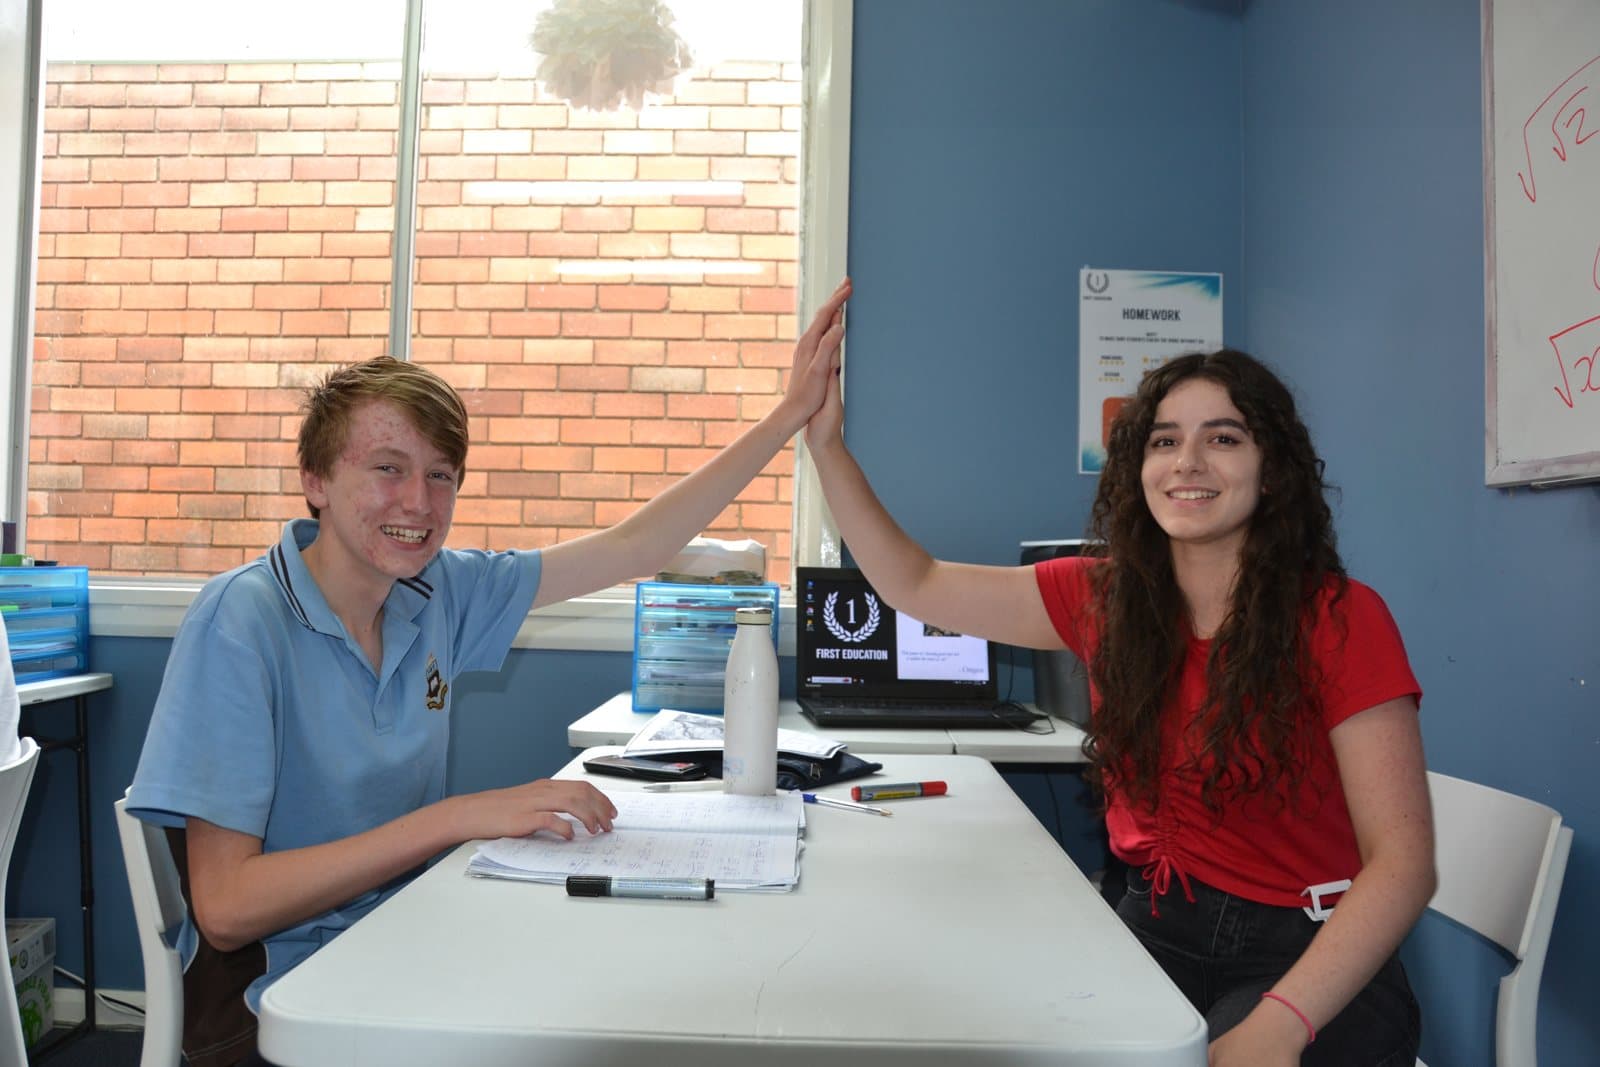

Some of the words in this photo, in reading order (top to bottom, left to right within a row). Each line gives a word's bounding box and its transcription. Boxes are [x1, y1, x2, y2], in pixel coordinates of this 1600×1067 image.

[1122, 308, 1181, 321] HOMEWORK
[815, 648, 841, 660] FIRST
[842, 648, 888, 660] EDUCATION
